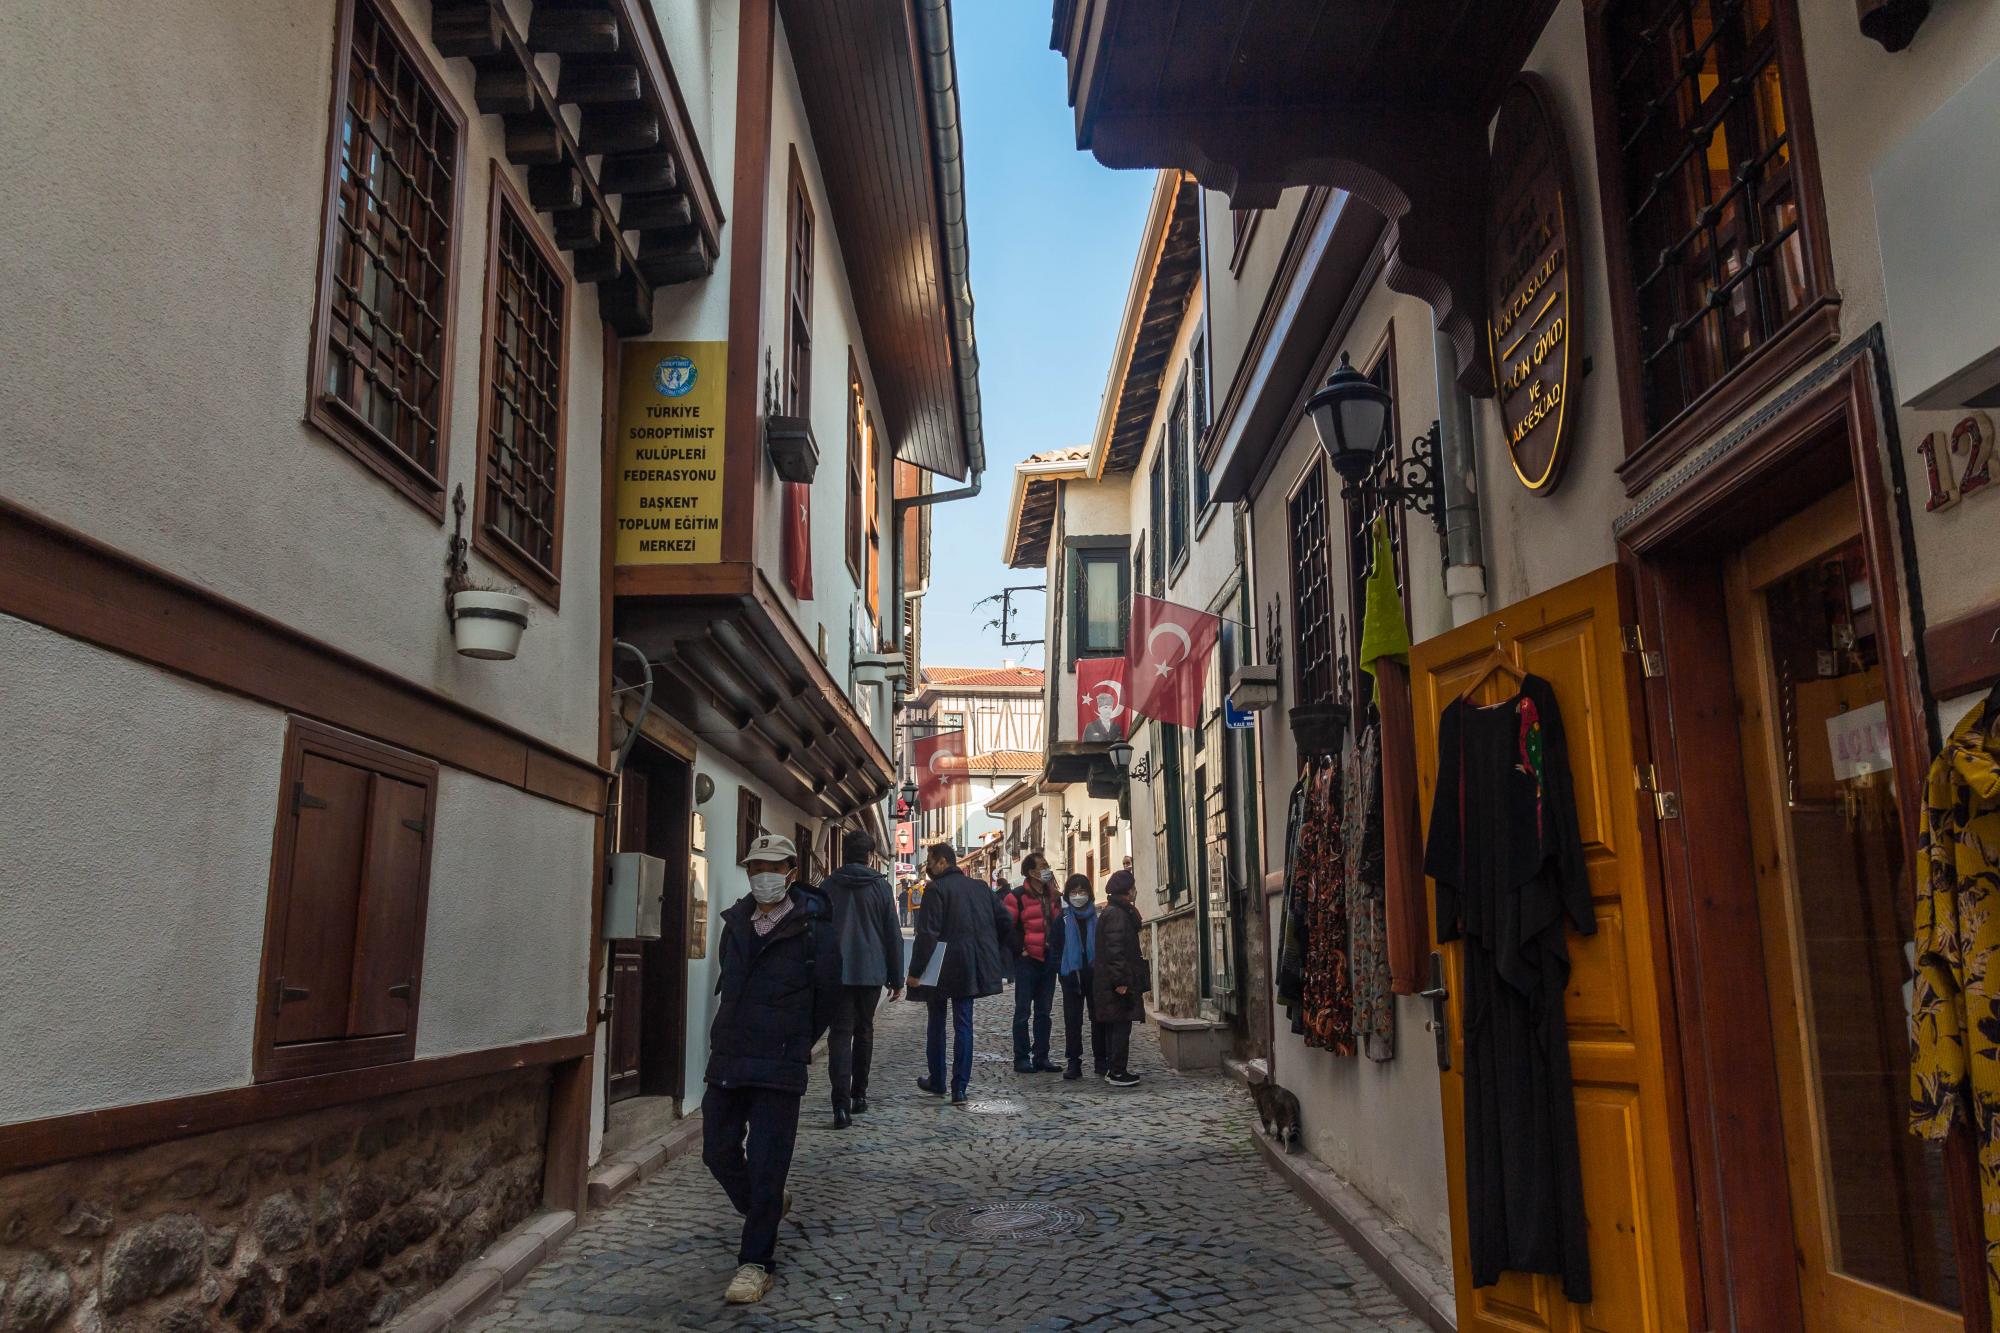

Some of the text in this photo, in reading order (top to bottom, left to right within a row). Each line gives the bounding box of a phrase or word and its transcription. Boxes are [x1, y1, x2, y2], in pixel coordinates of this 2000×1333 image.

[1529, 378, 1541, 403] VE
[646, 403, 700, 418] TÜRKİYE
[630, 424, 715, 439] SOROPTİMİST
[636, 445, 706, 460] KULÜPLERİ
[1917, 413, 1992, 512] 12
[624, 469, 716, 481] FEDERASYONU
[639, 497, 698, 512] BAŞKENT
[618, 514, 719, 530] TOPLUM EĞİTİM
[639, 537, 696, 552] MERKEZİ
[759, 838, 770, 849] B
